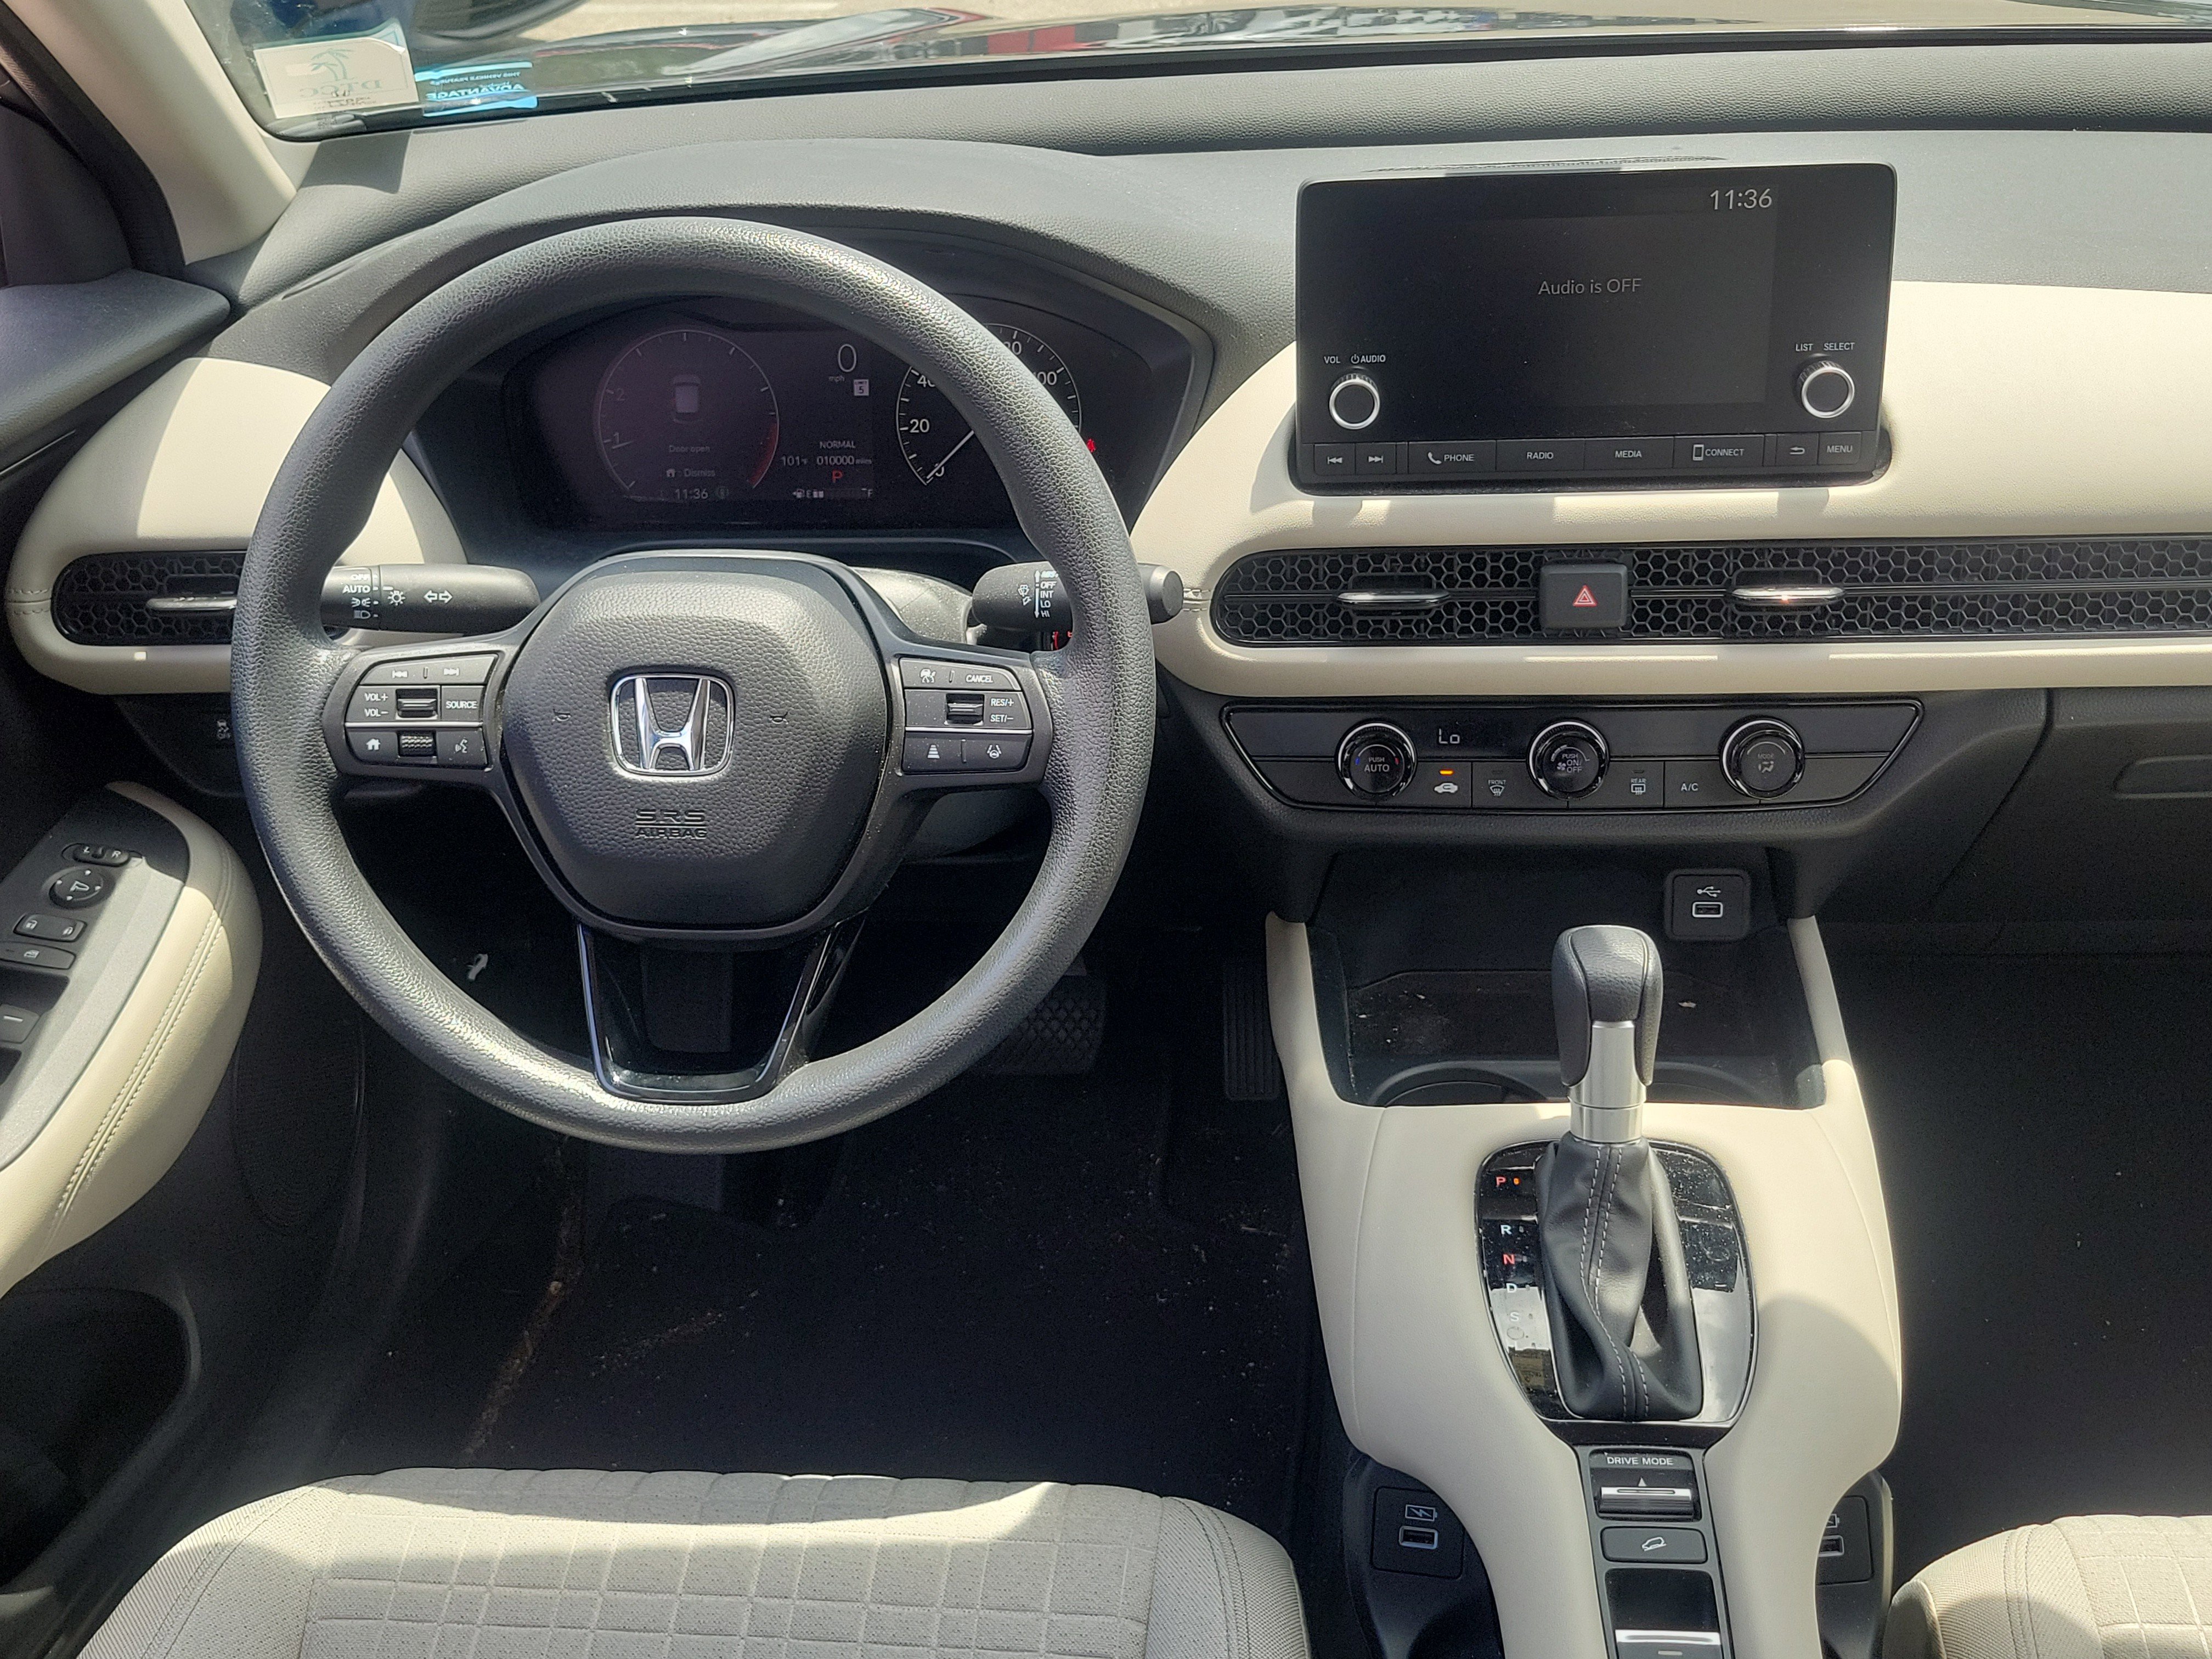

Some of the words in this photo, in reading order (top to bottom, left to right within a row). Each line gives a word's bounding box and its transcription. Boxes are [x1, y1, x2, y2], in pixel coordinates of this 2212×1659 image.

[1709, 188, 1772, 210] 11:36
[1537, 280, 1585, 295] Audio
[1590, 279, 1602, 294] is
[1607, 278, 1641, 292] OFF
[1795, 343, 1814, 352] LIST
[1824, 342, 1855, 351] SELECT
[837, 343, 857, 373] 0
[1323, 356, 1341, 364] VOL
[1361, 354, 1386, 363] AUDIO
[857, 385, 865, 393] 5
[910, 419, 929, 433] 20
[820, 440, 856, 449] NORMAL
[1826, 445, 1853, 453] MENU
[1527, 452, 1554, 460] RADIO
[1615, 450, 1642, 459] MEDIA
[1705, 448, 1745, 456] CONNECT
[781, 455, 800, 466] 101
[816, 455, 855, 465] 010000
[1444, 454, 1475, 462] PHONE
[832, 469, 844, 483] P
[675, 488, 709, 500] 11:36
[342, 584, 371, 594] AUTO
[1040, 590, 1054, 599] INT
[1040, 600, 1051, 608] LO
[1041, 610, 1050, 618] HI
[966, 675, 994, 683] CANCEL
[364, 692, 388, 701] VOL+
[445, 701, 478, 709] SOURCE
[990, 698, 1014, 707] RES/+
[1438, 729, 1460, 744] Lo
[1364, 764, 1390, 772] AUTO
[1566, 766, 1583, 774] OFF
[1681, 783, 1699, 792] A/C
[636, 809, 706, 823] SRS
[636, 828, 708, 840] AIRBAG
[111, 850, 121, 859] R
[1496, 1177, 1506, 1186] P
[1500, 1224, 1512, 1235] R
[1503, 1254, 1516, 1265] N
[1506, 1283, 1517, 1293] D
[1643, 1457, 1673, 1465] MODE
